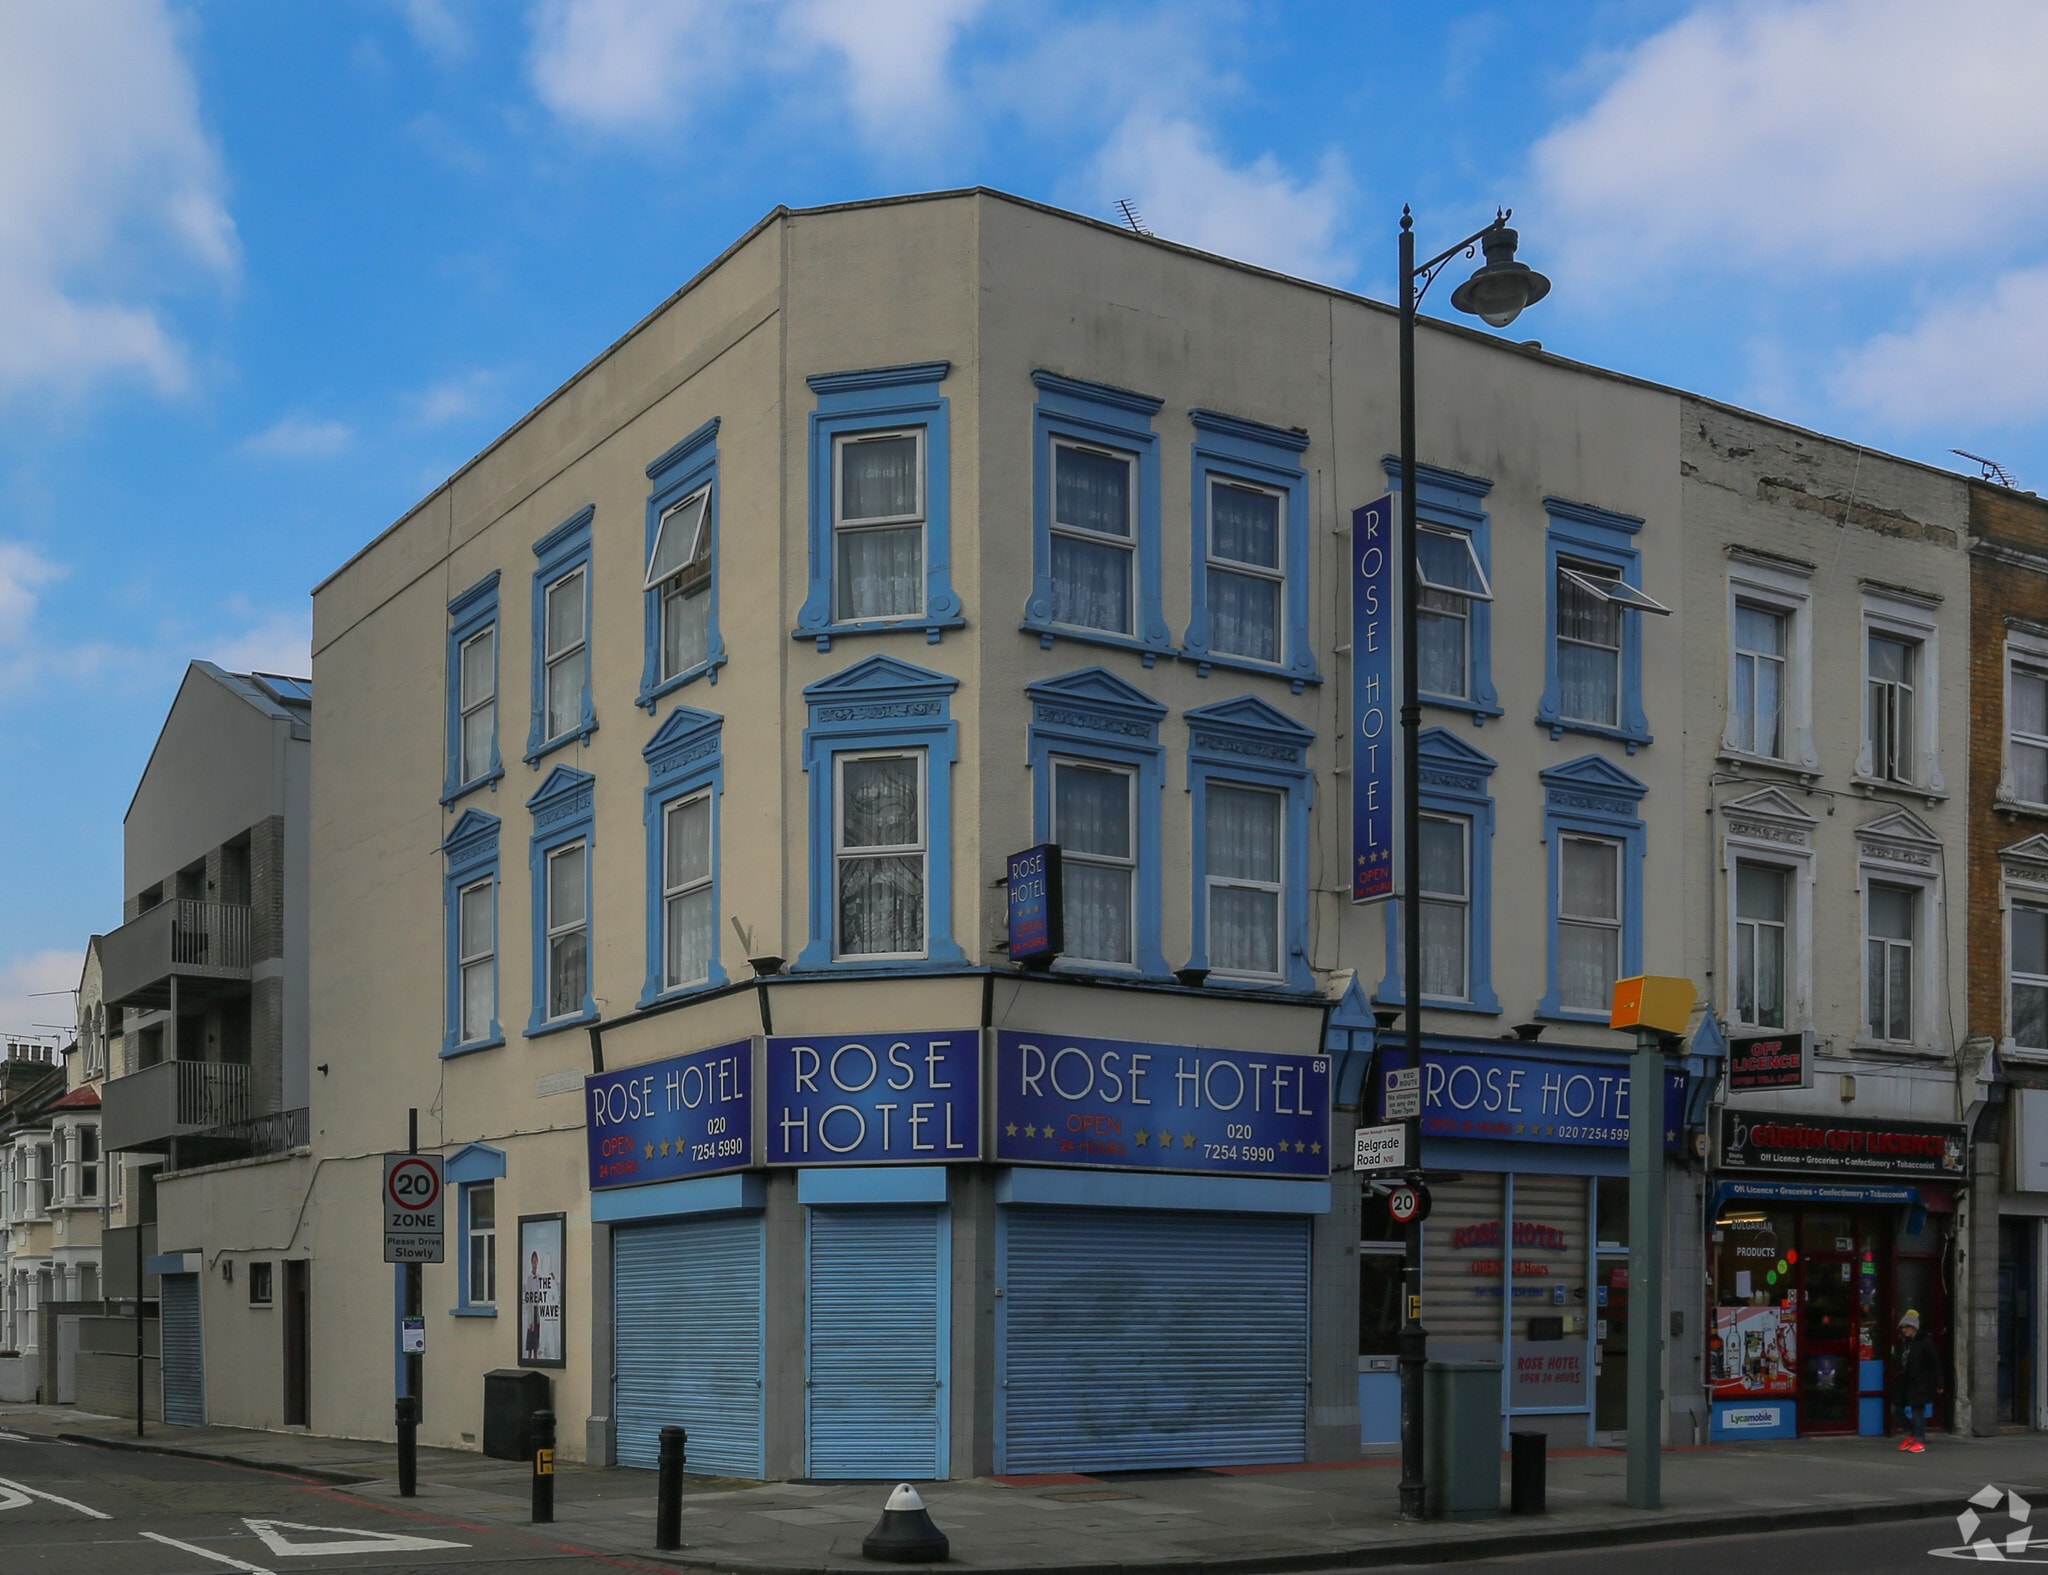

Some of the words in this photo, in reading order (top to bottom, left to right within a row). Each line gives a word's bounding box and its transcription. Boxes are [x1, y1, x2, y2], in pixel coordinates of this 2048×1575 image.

[1362, 510, 1384, 652] ROSE
[1362, 672, 1384, 847] HOTEL
[1012, 854, 1042, 880] ROSE
[1359, 866, 1389, 884] OPEN
[1011, 879, 1045, 904] HOTEL
[1751, 1041, 1782, 1056] OFF
[791, 1041, 951, 1093] ROSE
[1313, 1060, 1326, 1074] 69
[1732, 1054, 1800, 1072] LICENCE
[1018, 1044, 1151, 1105] ROSE
[1175, 1057, 1313, 1116] HOTEL
[1399, 1079, 1418, 1087] ROUTE
[1674, 1077, 1684, 1088] 71
[593, 1076, 655, 1127] ROSE
[666, 1057, 743, 1113] HOTEL
[1425, 1063, 1525, 1113] ROSE
[1541, 1074, 1631, 1119] HOTE
[707, 1117, 726, 1135] 020
[780, 1102, 963, 1153] HOTEL
[1066, 1114, 1122, 1136] OPEN
[1227, 1124, 1252, 1140] 020
[1558, 1125, 1579, 1140] 020
[1581, 1127, 1608, 1140] 7254
[1610, 1128, 1630, 1141] 599
[603, 1136, 635, 1158] OPEN
[691, 1142, 717, 1162] 7254
[718, 1137, 743, 1158] 5990
[1358, 1137, 1399, 1152] Belgrade
[1204, 1144, 1237, 1161] 7254
[1242, 1145, 1275, 1162] 5990
[1357, 1153, 1380, 1166] Road
[1384, 1155, 1395, 1163] N16
[1760, 1153, 1771, 1161] Off
[1773, 1154, 1800, 1163] Licence
[1806, 1155, 1839, 1165] Groceries
[1845, 1157, 1890, 1169] Confectionery
[1896, 1160, 1935, 1170] Tobacconist
[397, 1174, 431, 1195] 20
[1746, 1186, 1774, 1195] Licence
[1780, 1187, 1812, 1197] Groceries
[1819, 1188, 1863, 1199] Confectionery
[1870, 1190, 1908, 1198] Tobacconist
[1394, 1195, 1413, 1211] 20
[392, 1214, 436, 1227] ZONE
[1731, 1220, 1773, 1230] BULGARIAN
[387, 1237, 415, 1245] Please
[418, 1237, 441, 1246] Drive
[1454, 1222, 1503, 1249] ROSE
[1512, 1222, 1568, 1251] HOTEL
[395, 1248, 434, 1259] Slowly
[1736, 1247, 1776, 1257] PRODUCTS
[1471, 1260, 1503, 1276] OPEN
[1524, 1261, 1549, 1276] Hours
[538, 1277, 551, 1289] THE
[525, 1291, 547, 1303] GREAT
[539, 1305, 559, 1317] WAVE
[1517, 1356, 1544, 1371] ROSE
[1548, 1356, 1580, 1370] HOTEL
[1520, 1373, 1540, 1384] OPEN
[1554, 1372, 1580, 1384] HOURS
[1731, 1412, 1772, 1424] Lycamobile
